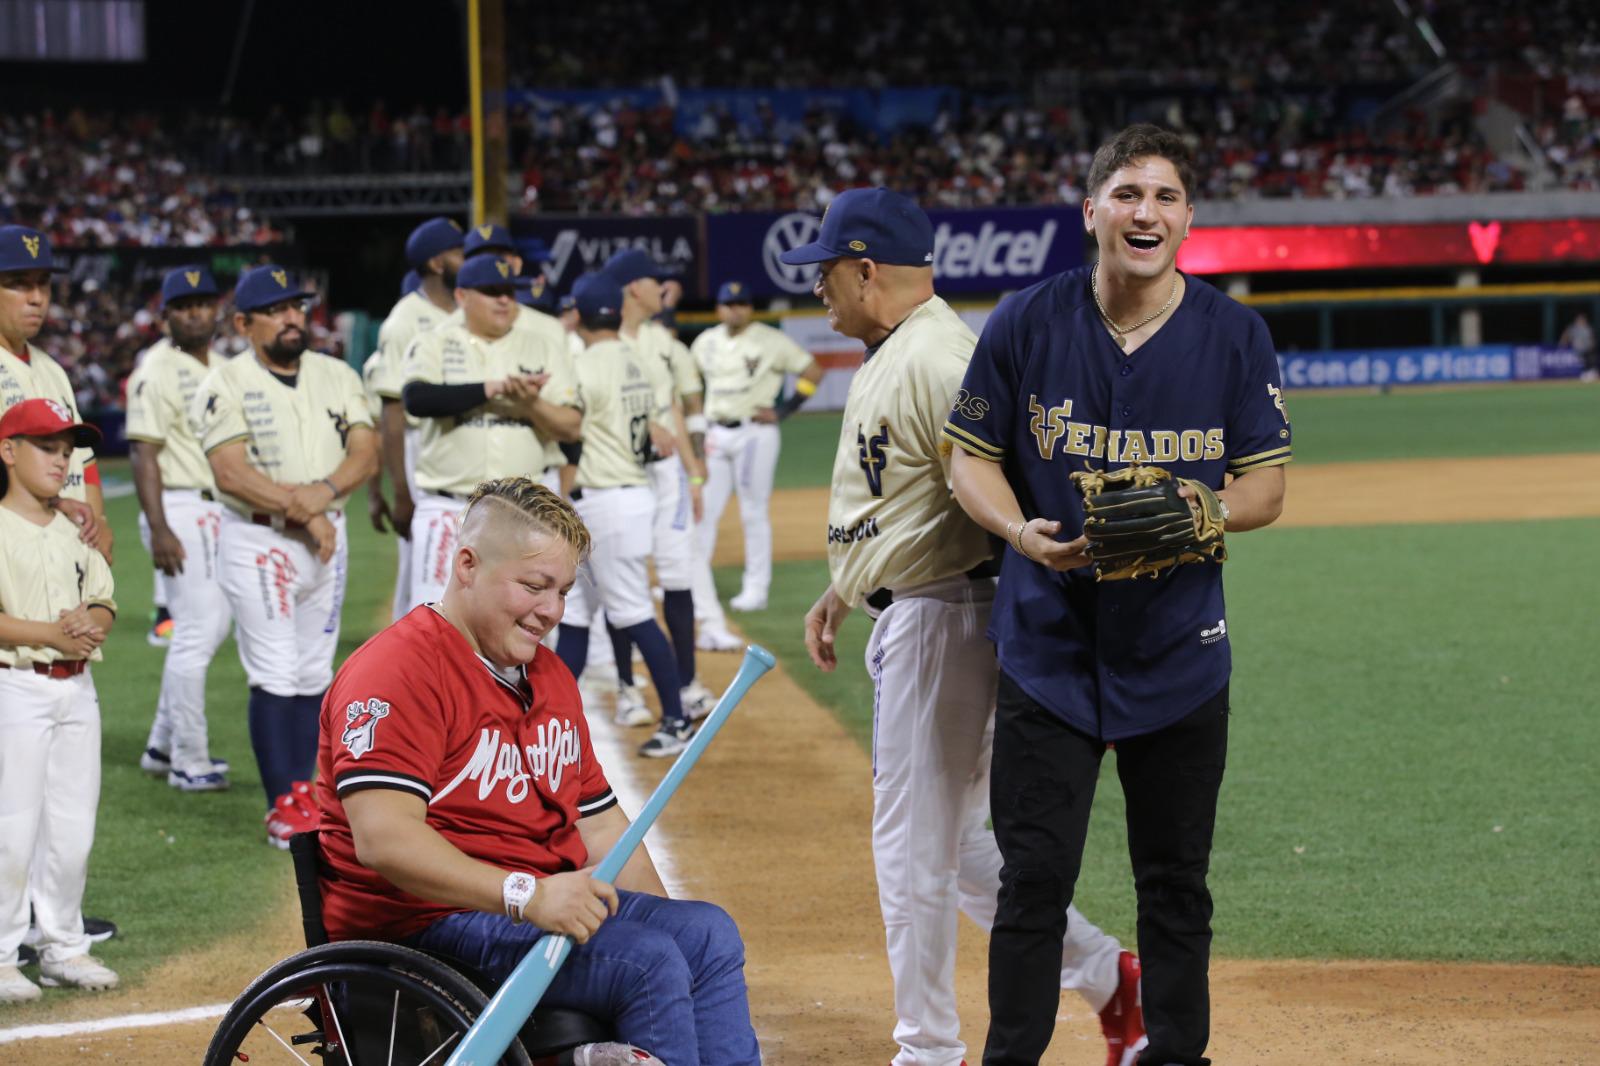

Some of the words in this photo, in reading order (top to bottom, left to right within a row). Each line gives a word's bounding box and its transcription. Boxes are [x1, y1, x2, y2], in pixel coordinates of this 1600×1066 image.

[933, 218, 1058, 280] telcel
[1422, 351, 1511, 379] Plaza
[1029, 394, 1225, 462] VENADOS
